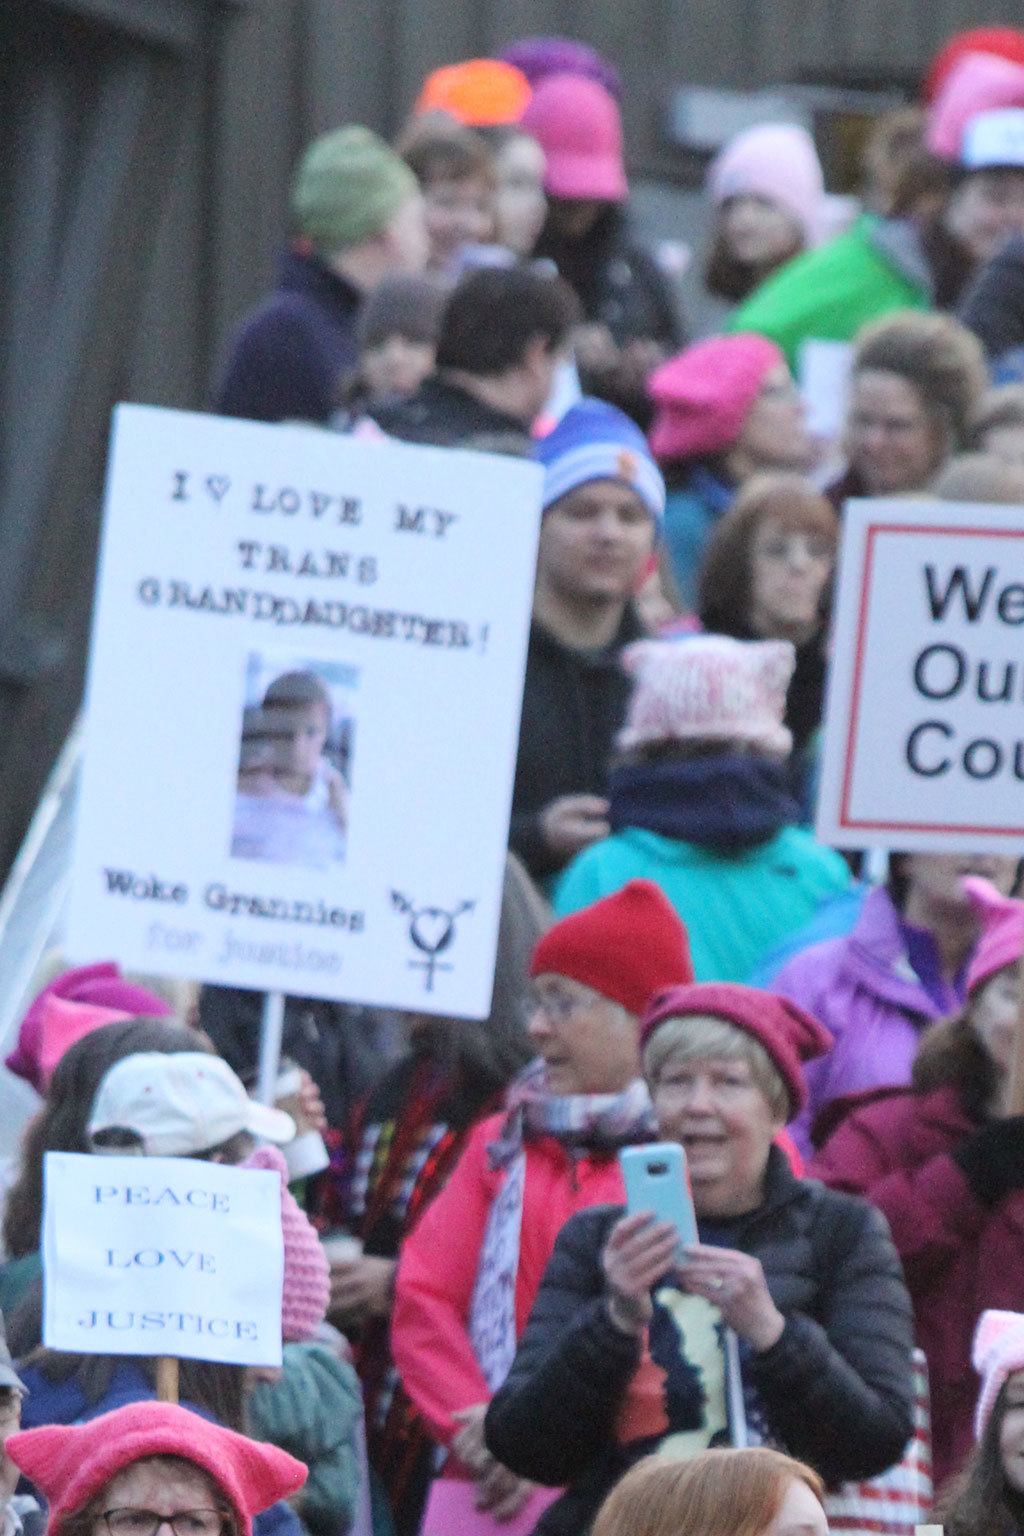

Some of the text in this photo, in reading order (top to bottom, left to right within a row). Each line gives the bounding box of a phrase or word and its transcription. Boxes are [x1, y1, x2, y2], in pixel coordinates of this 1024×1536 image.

[171, 470, 456, 537] I LOVE MY
[237, 540, 378, 585] TRANS
[104, 867, 364, 934] Woke Grannies
[94, 1185, 230, 1214] PEACE
[105, 1249, 217, 1274] LOVE
[78, 1310, 259, 1341] JUSTICE
